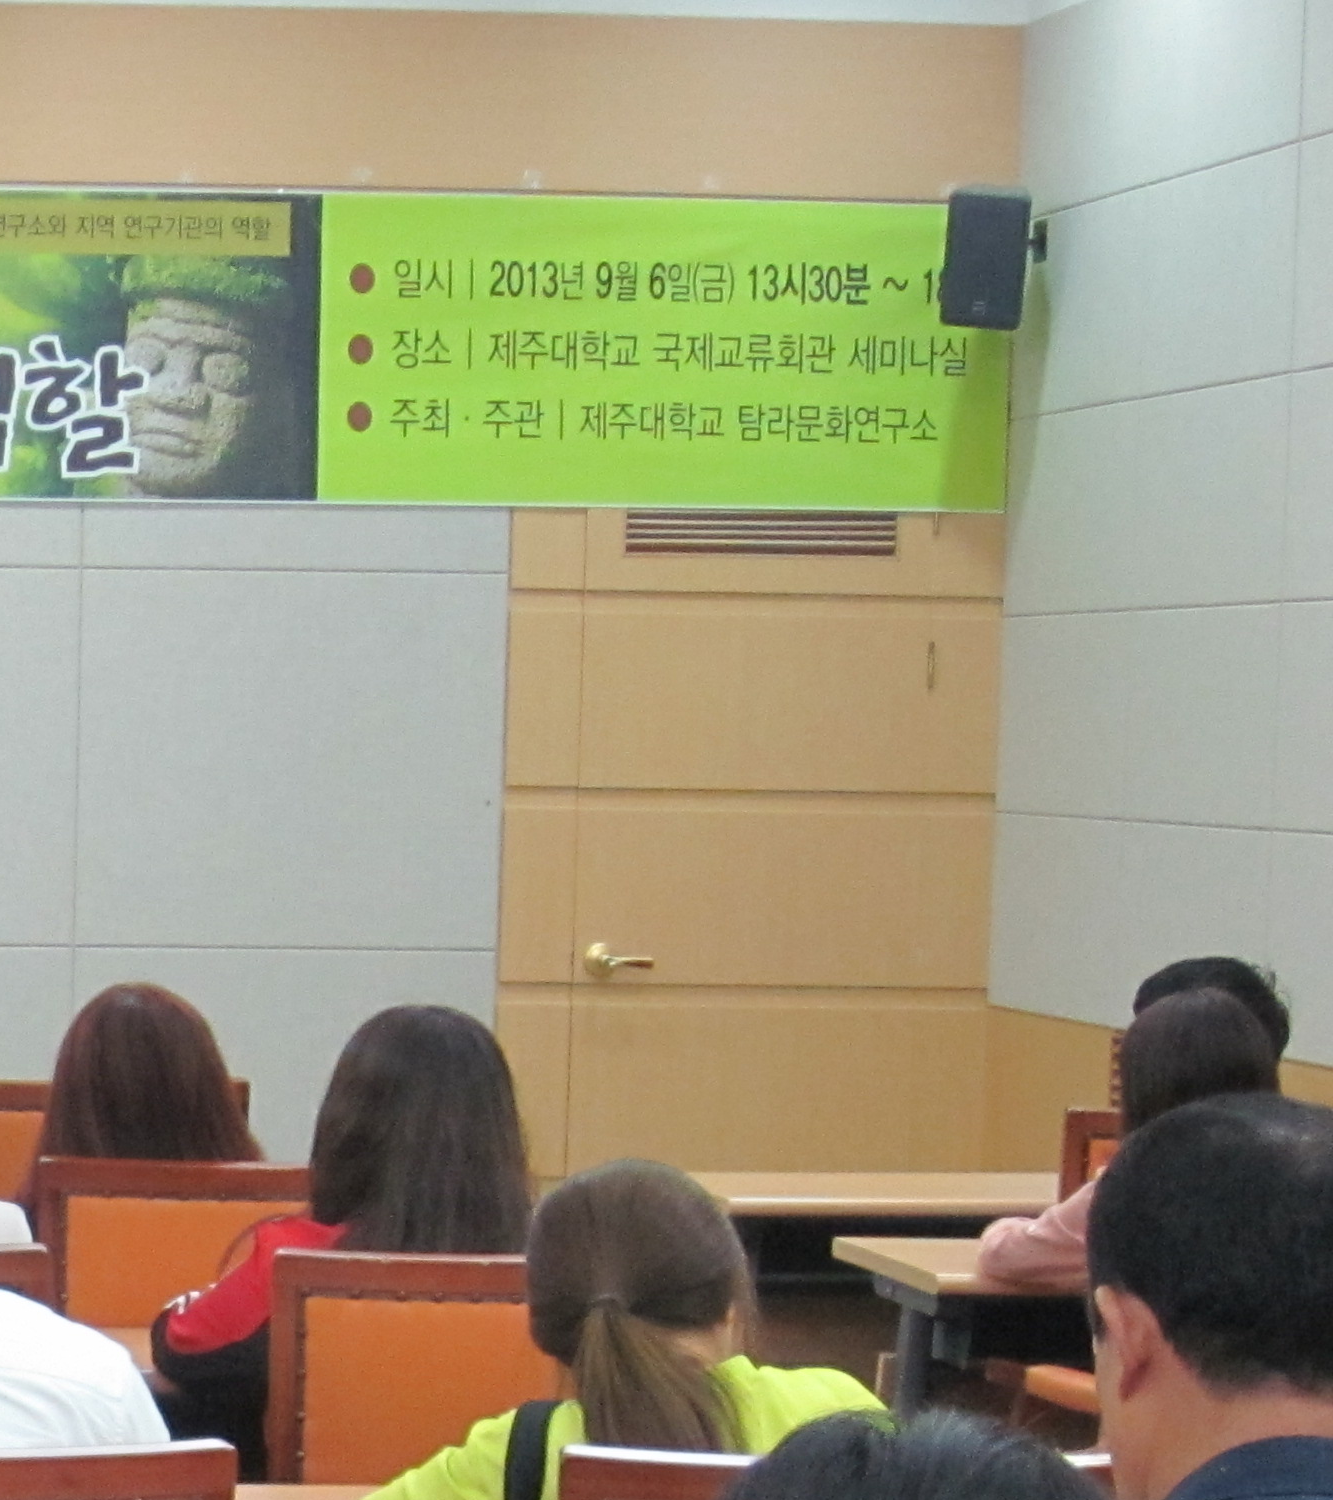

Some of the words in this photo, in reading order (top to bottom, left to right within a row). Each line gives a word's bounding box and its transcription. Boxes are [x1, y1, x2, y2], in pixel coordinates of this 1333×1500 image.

[74, 212, 117, 240] 지역
[123, 213, 224, 241] 연구기관의
[231, 215, 273, 242] 역할
[393, 258, 454, 300] 일시
[490, 259, 585, 303] 2013년
[595, 260, 639, 303] 9월
[649, 260, 735, 305] 6일(금)
[748, 263, 870, 306] 13시30분
[391, 329, 452, 369] 장소
[488, 331, 640, 369] 제주대학교
[652, 332, 836, 375] 국제교류회관
[848, 335, 969, 377] 세미나실
[390, 398, 451, 438] 주최
[482, 400, 544, 440] 주관
[579, 402, 726, 440] 제주대학교
[738, 403, 939, 444] 탐라문화연구소
